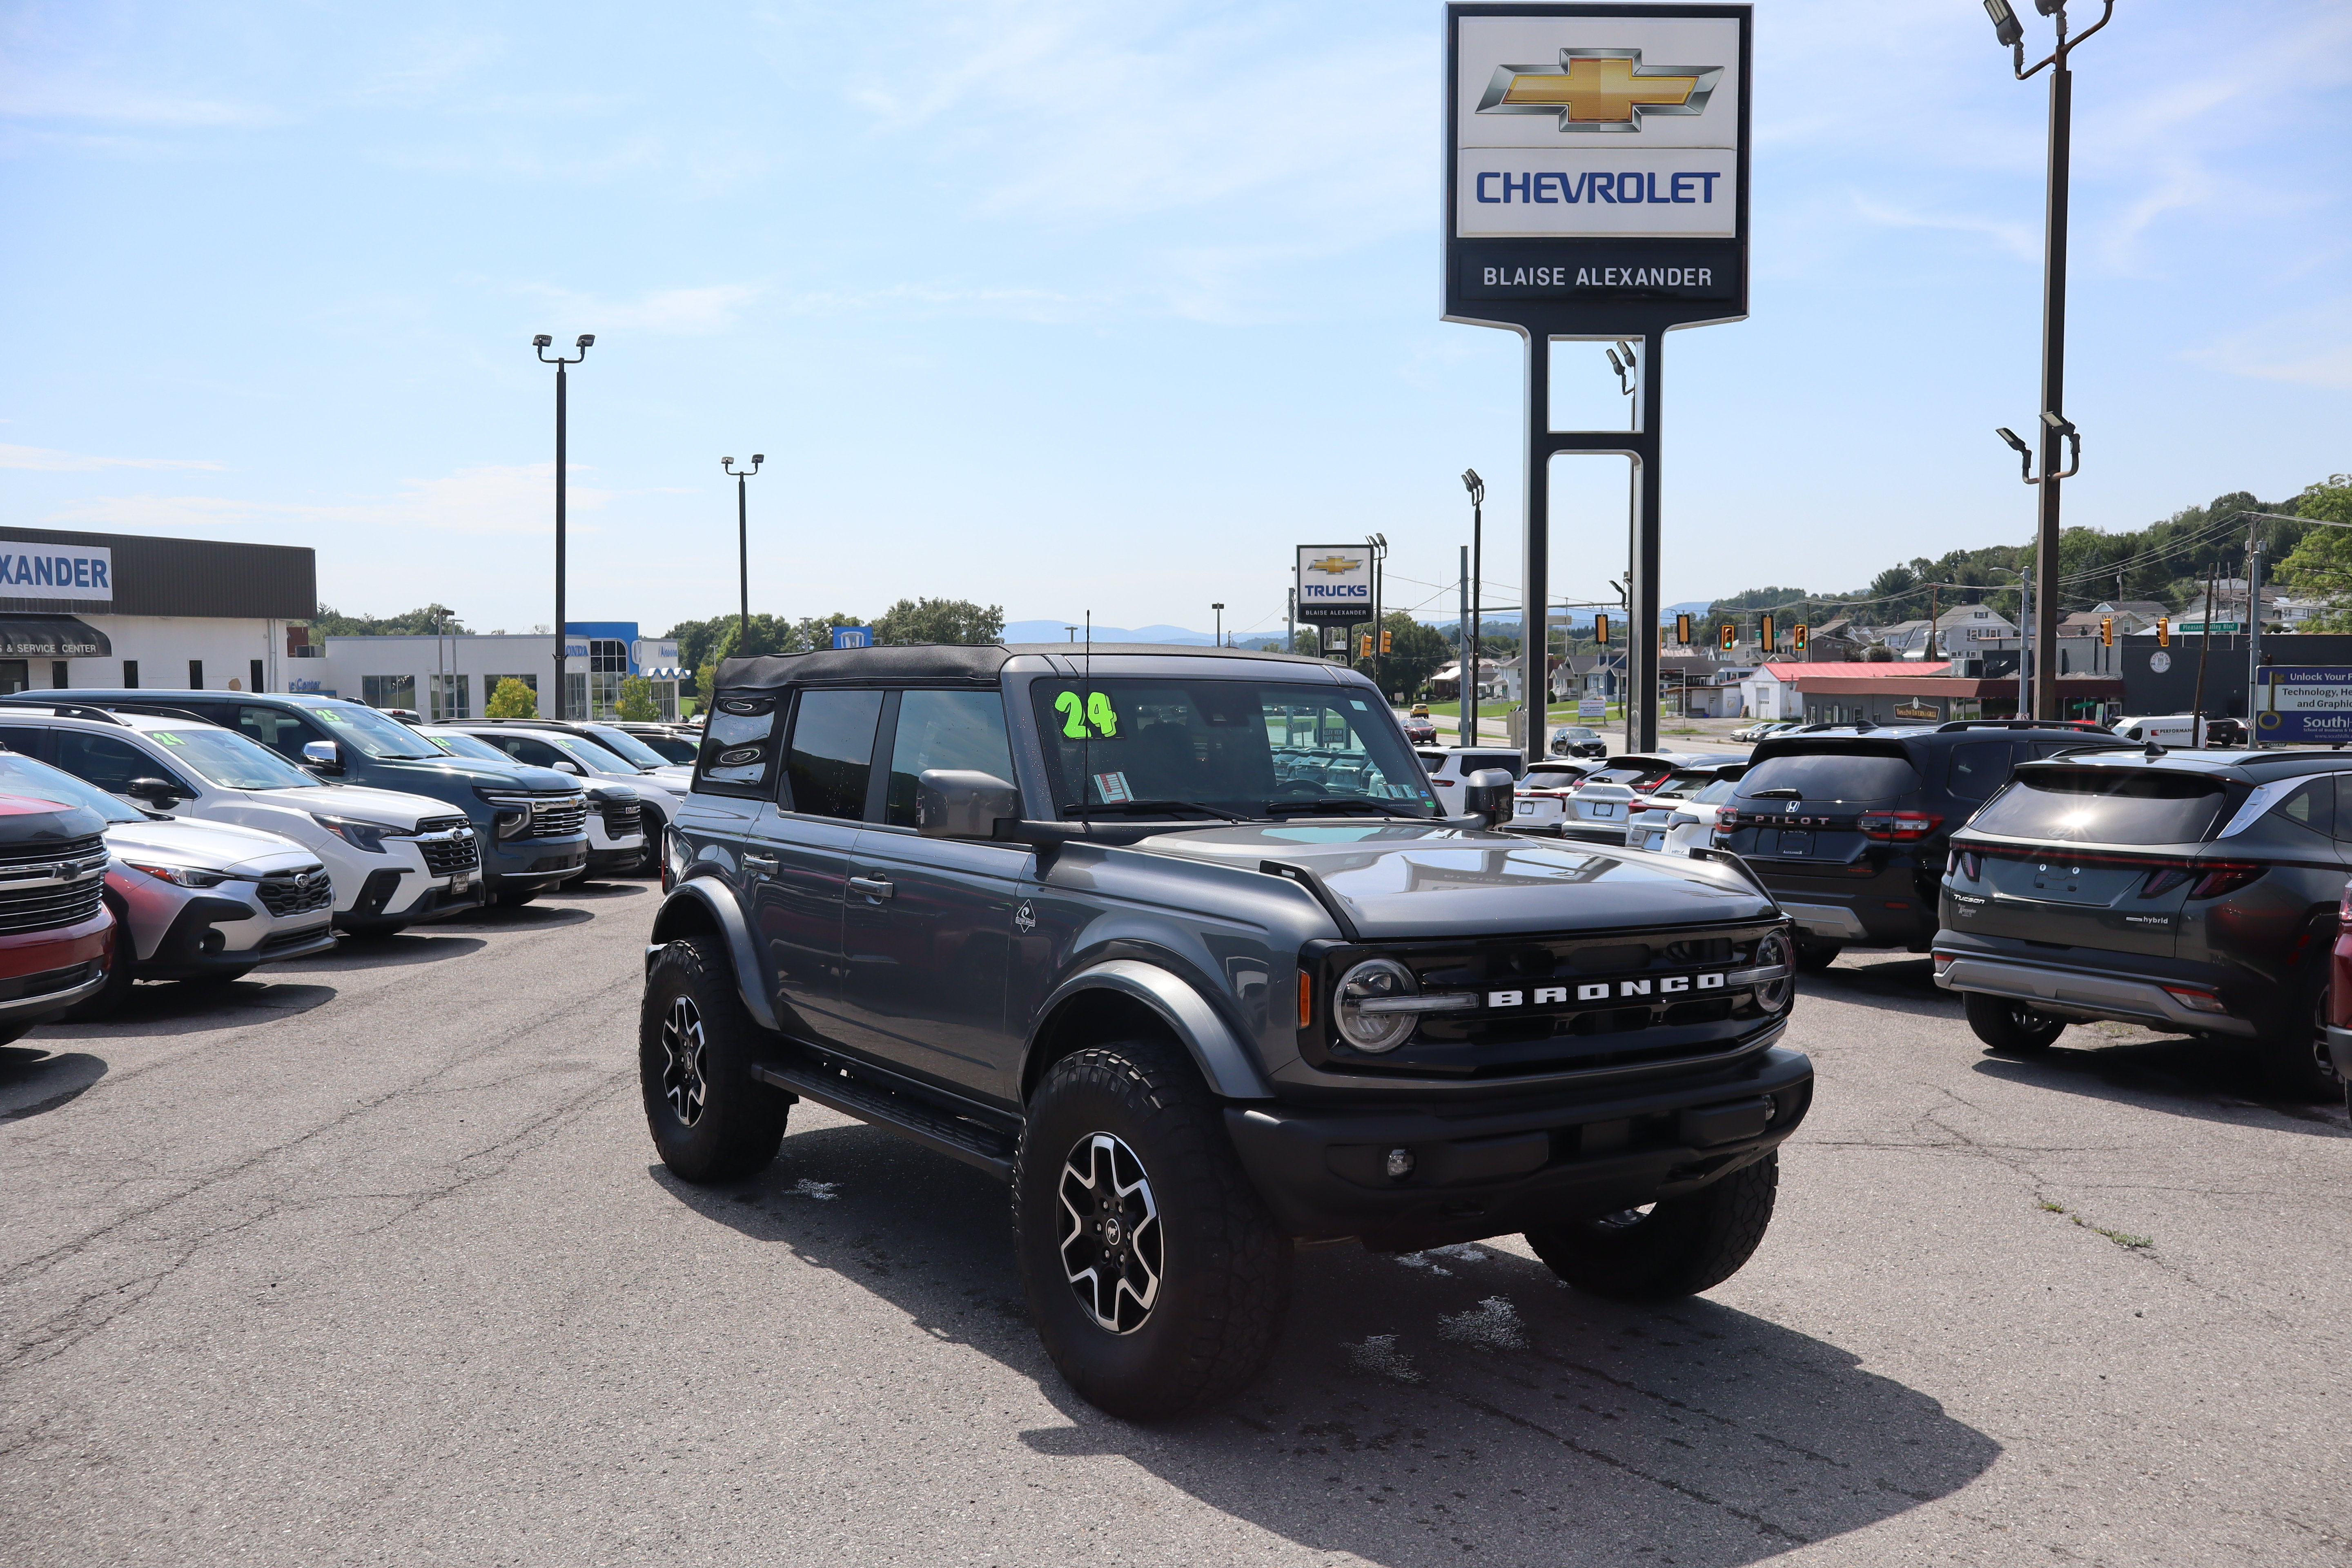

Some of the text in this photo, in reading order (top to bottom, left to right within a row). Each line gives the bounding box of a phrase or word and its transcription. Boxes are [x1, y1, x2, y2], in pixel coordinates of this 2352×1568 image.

[1477, 172, 1720, 203] CHEVROLET
[1484, 267, 1712, 287] BLAISE ALEXANDER
[0, 554, 109, 588] XANDER
[1305, 585, 1367, 597] TRUCKS
[7, 644, 13, 653] &
[17, 644, 56, 653] SERVICE
[62, 644, 96, 653] CENTER
[565, 645, 589, 657] ONDA
[2290, 673, 2322, 681] Unlock
[2282, 688, 2339, 697] Technology,
[316, 710, 342, 722] 25
[1055, 691, 1117, 738] 24
[153, 733, 187, 745] 24
[1755, 815, 1829, 825] PILOT
[2143, 916, 2168, 924] hybrid
[1488, 973, 1724, 1007] BRONCO
